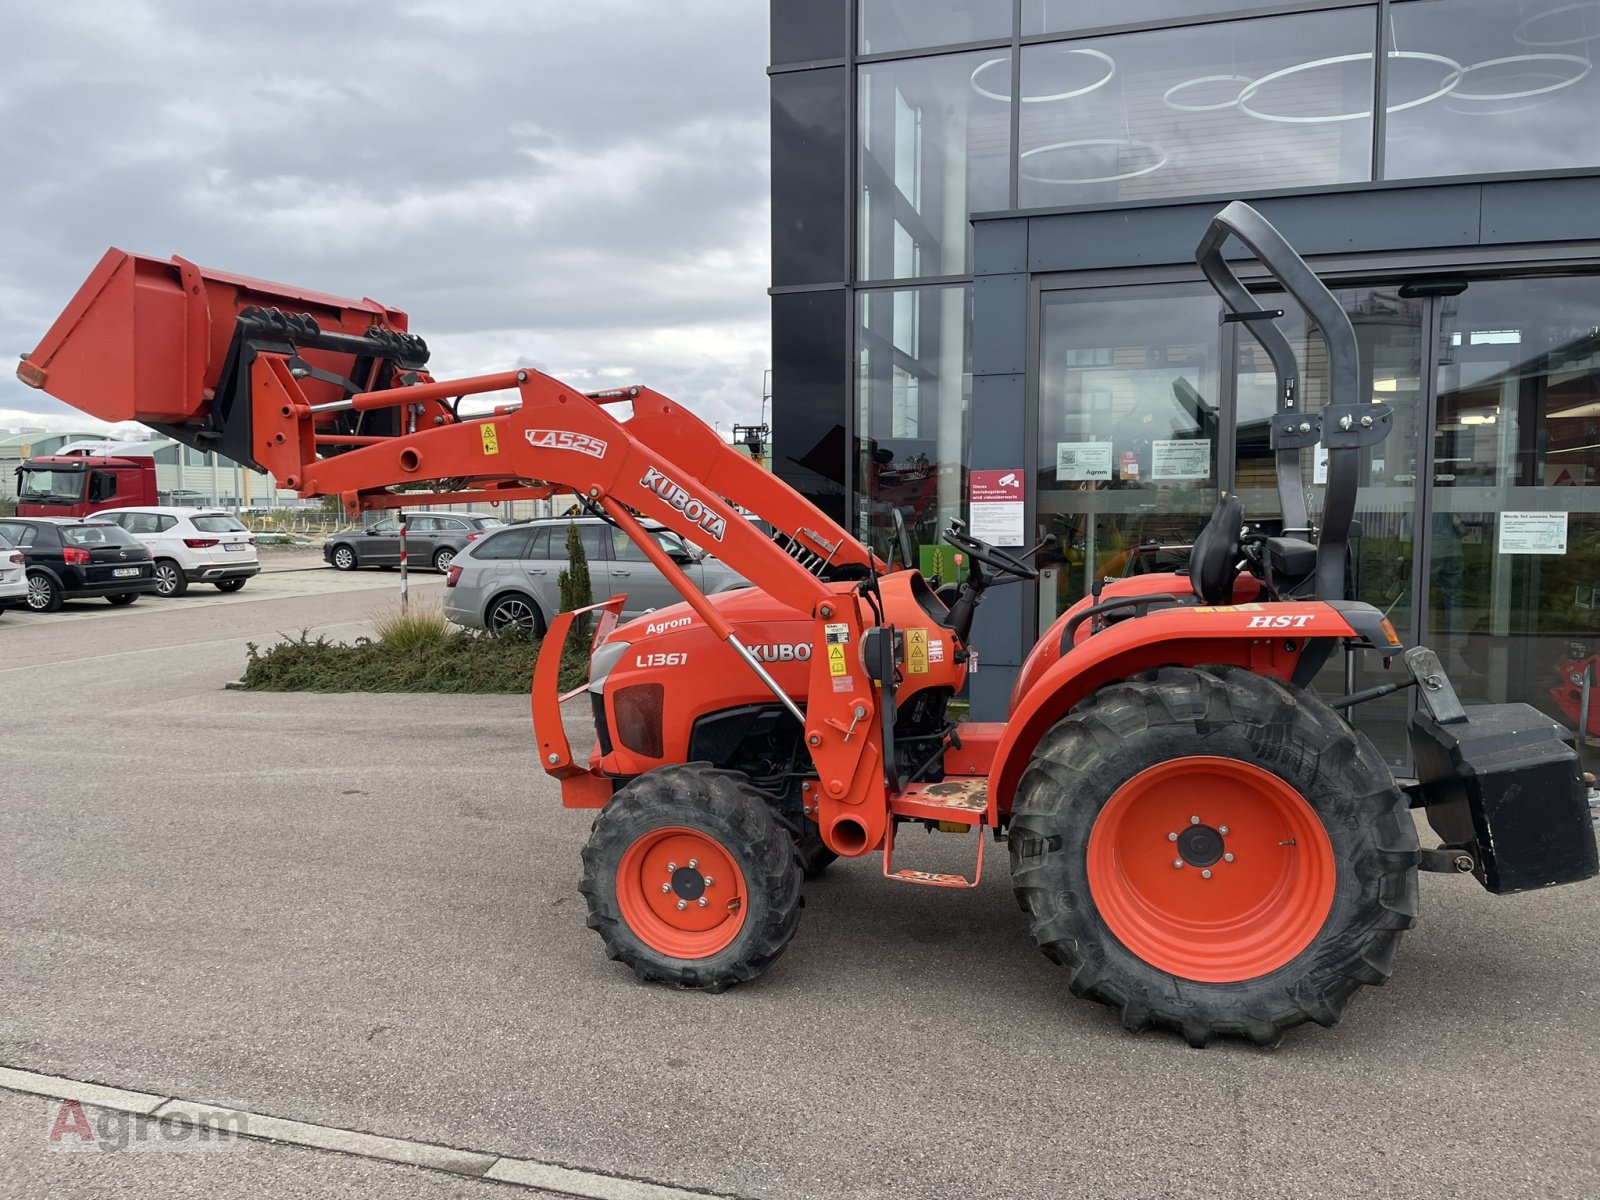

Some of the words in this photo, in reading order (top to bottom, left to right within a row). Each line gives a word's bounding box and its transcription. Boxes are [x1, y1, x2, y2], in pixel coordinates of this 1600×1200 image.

[529, 431, 605, 456] LA525
[1086, 469, 1108, 477] Agrom
[640, 466, 726, 541] KUBOTA
[646, 616, 692, 636] Agrom
[1246, 614, 1315, 628] HST
[636, 652, 688, 668] L1361
[747, 642, 813, 663] KUBO
